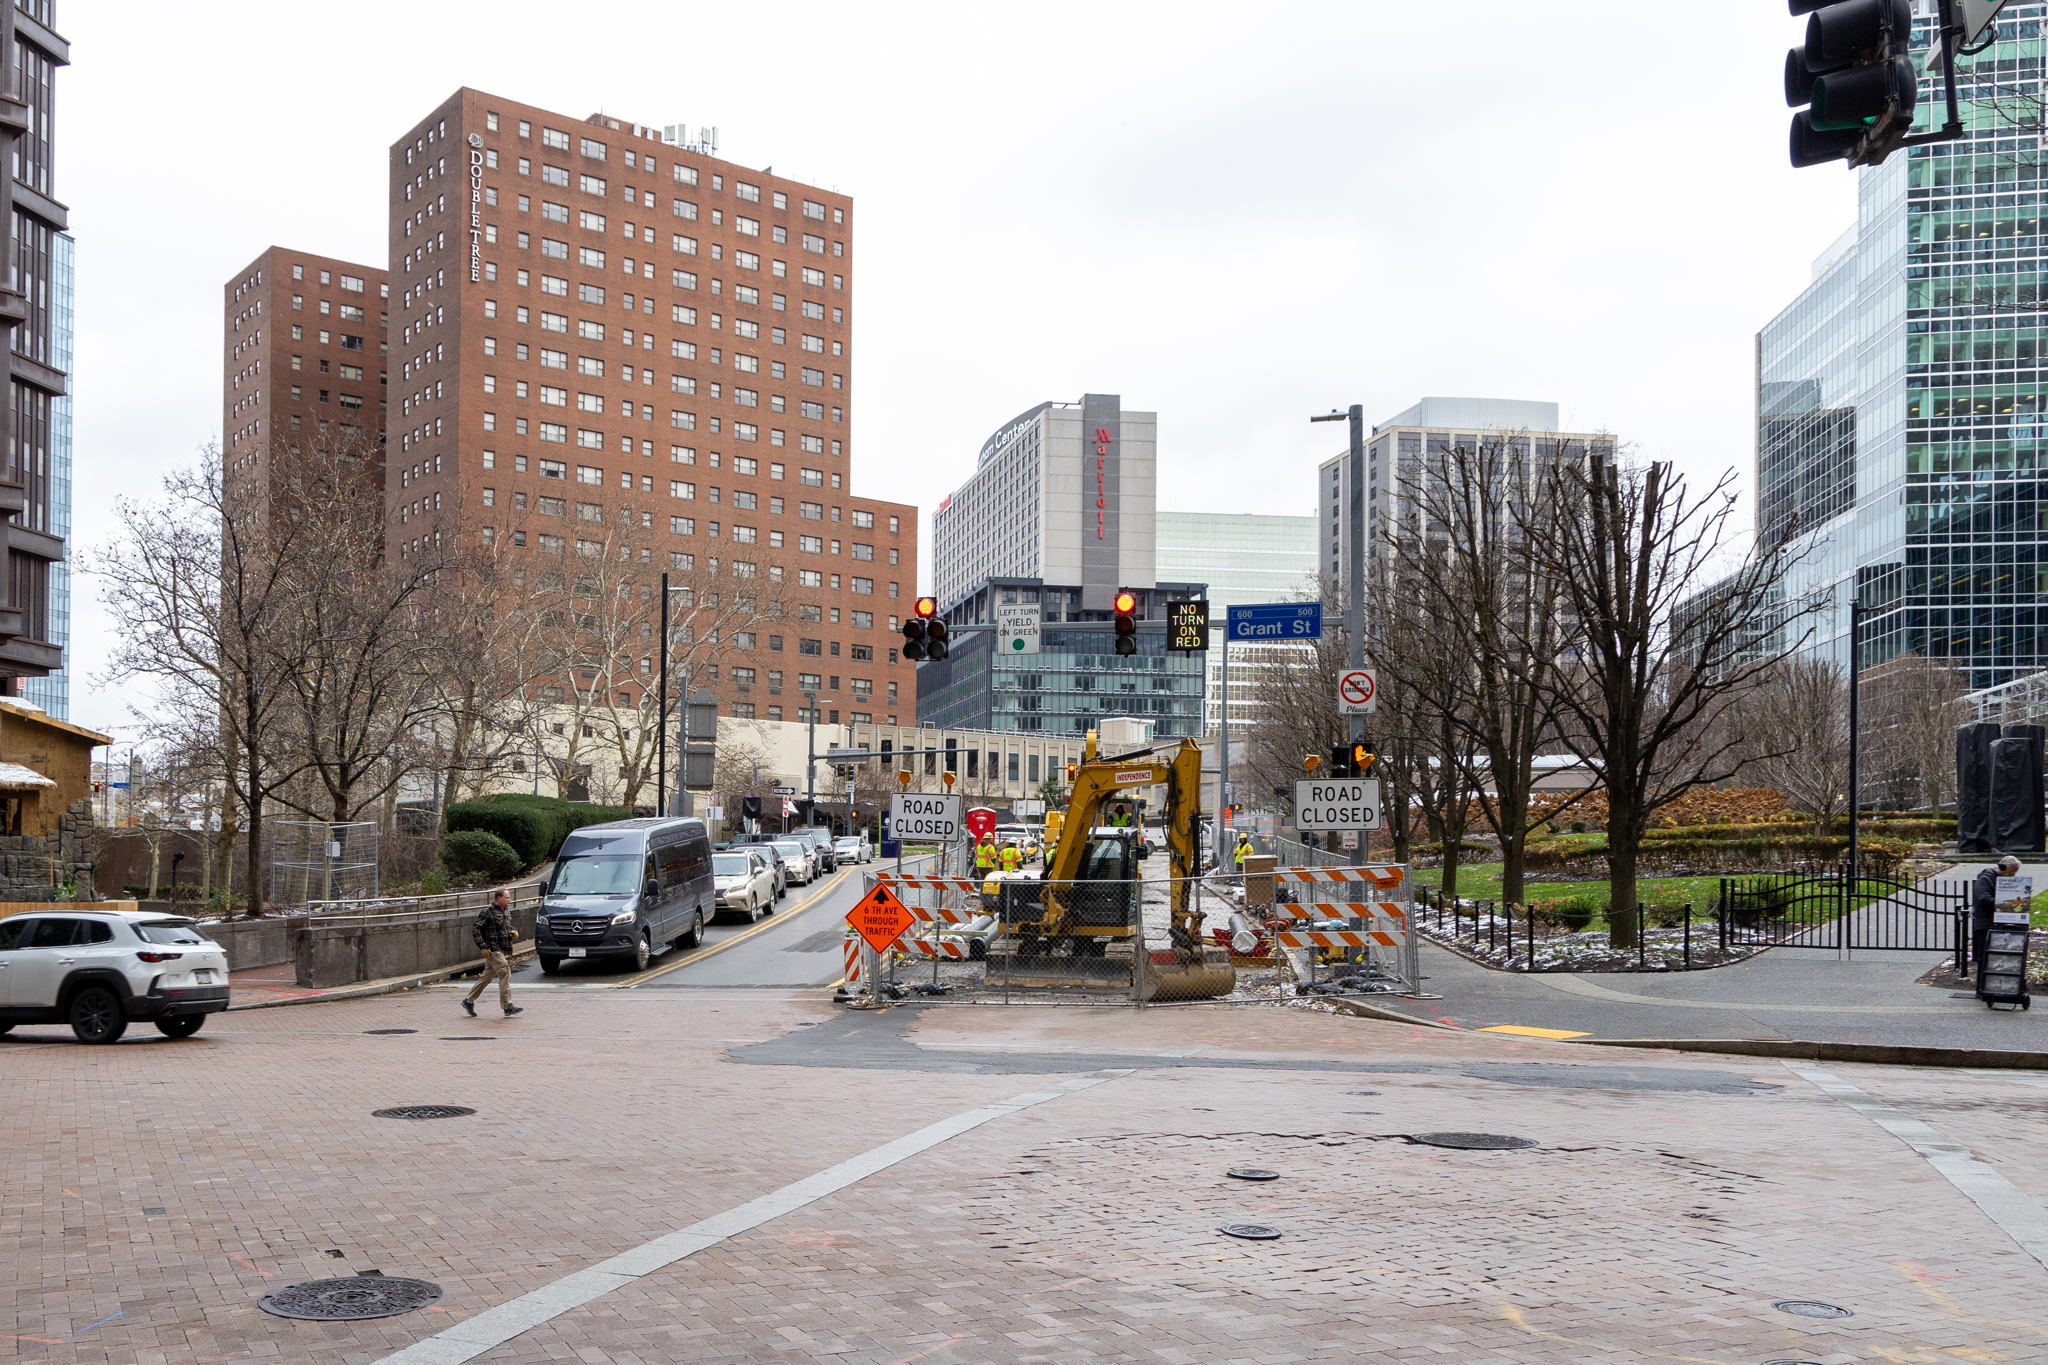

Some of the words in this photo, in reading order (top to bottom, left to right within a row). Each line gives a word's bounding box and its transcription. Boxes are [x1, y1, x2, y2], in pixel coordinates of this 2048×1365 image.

[995, 419, 1031, 449] Center
[1091, 427, 1112, 540] Marriott
[999, 608, 1016, 616] LEFT
[1020, 608, 1039, 616] TURN
[1179, 604, 1197, 615] NO
[1237, 610, 1253, 618] 600
[1297, 608, 1313, 616] 500
[1006, 618, 1033, 627] YIELD
[1172, 615, 1205, 626] TURN
[999, 629, 1010, 637] ON
[1013, 628, 1038, 637] GREEN
[1179, 626, 1197, 636] ON
[1237, 621, 1283, 636] Grant
[1292, 619, 1312, 635] St
[1176, 637, 1201, 648] RED
[1346, 705, 1369, 713] Please
[1116, 771, 1151, 782] INDEPENDENCE
[1312, 786, 1362, 802] ROAD
[903, 800, 944, 815] ROAD
[1302, 807, 1374, 823] CLOSED
[895, 818, 954, 835] CLOSED
[864, 906, 869, 914] 6
[872, 906, 881, 914] TH
[884, 907, 899, 915] AVE
[863, 916, 899, 926] THROUGH
[865, 927, 895, 936] TRAFFIC
